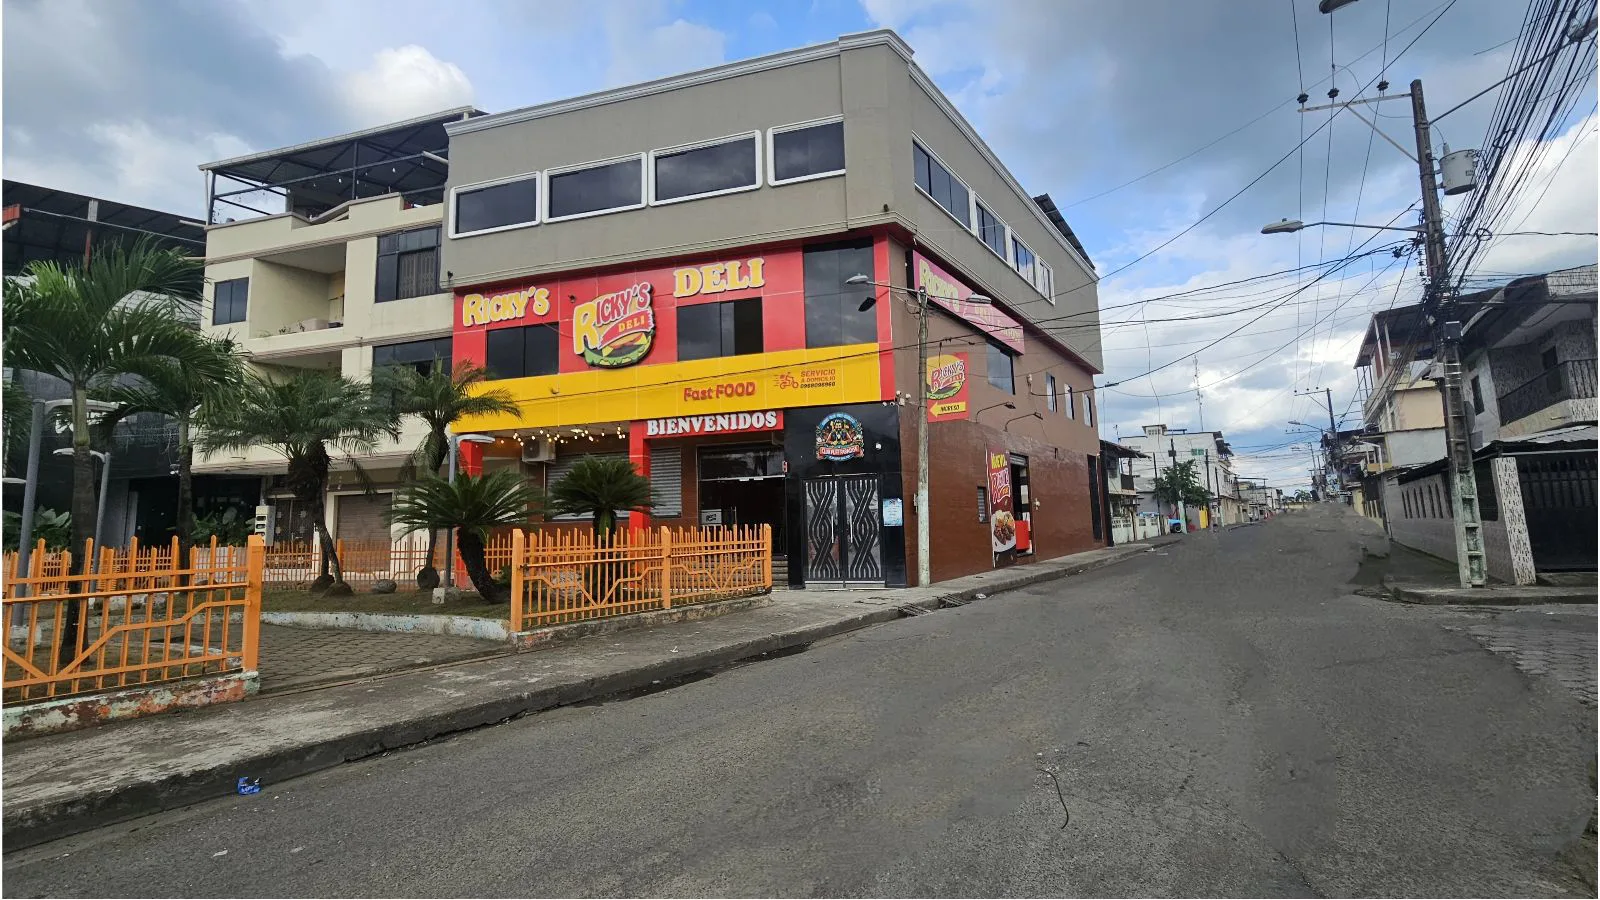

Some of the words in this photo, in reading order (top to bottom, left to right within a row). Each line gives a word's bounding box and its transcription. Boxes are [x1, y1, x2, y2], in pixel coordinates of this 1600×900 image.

[673, 257, 765, 298] DELI
[618, 315, 646, 333] DELI
[800, 369, 836, 378] SERVICIO
[683, 387, 714, 402] Fast
[715, 381, 756, 399] FOOD
[646, 411, 778, 436] BIENVENIDOS
